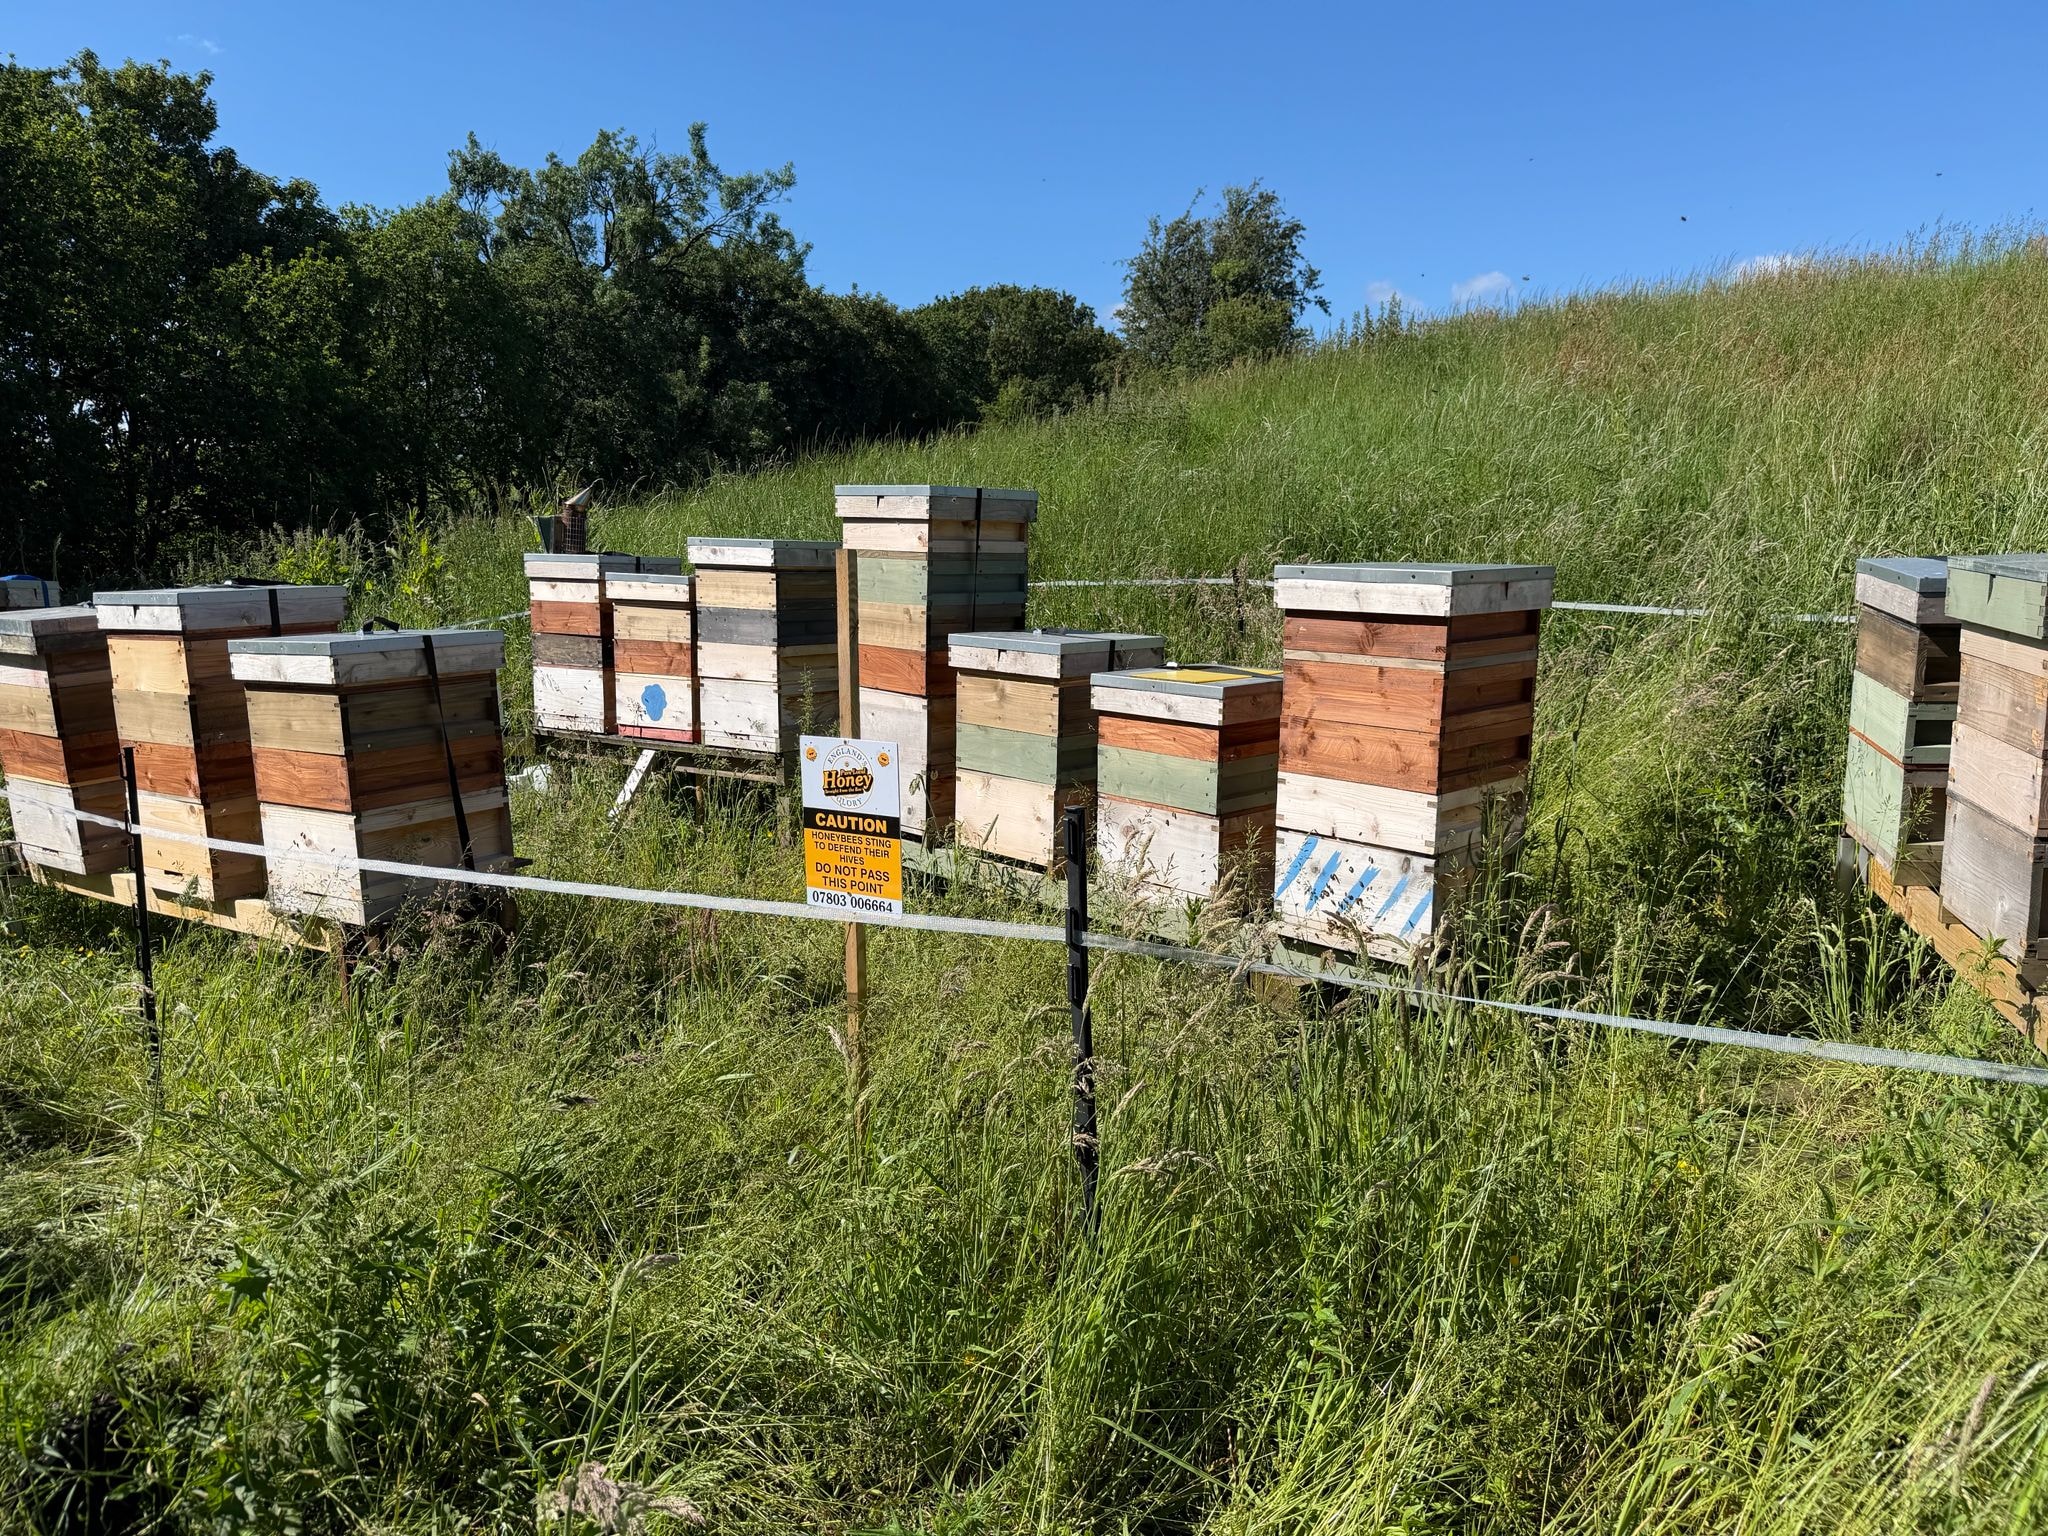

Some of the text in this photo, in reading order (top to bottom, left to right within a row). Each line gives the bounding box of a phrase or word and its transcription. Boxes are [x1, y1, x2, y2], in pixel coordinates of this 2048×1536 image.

[827, 748, 868, 766] ENGLAND'S
[823, 770, 872, 789] Honey
[836, 797, 861, 806] GLORY
[815, 813, 887, 834] CAUTION
[811, 831, 892, 849] HONEYBEES STING
[814, 841, 890, 858] TO DEFEND THEIR
[840, 855, 865, 865] HIVES
[815, 862, 890, 882] DO NOT PASS
[822, 876, 884, 894] THIS POINT
[812, 890, 893, 913] 07803 006664
